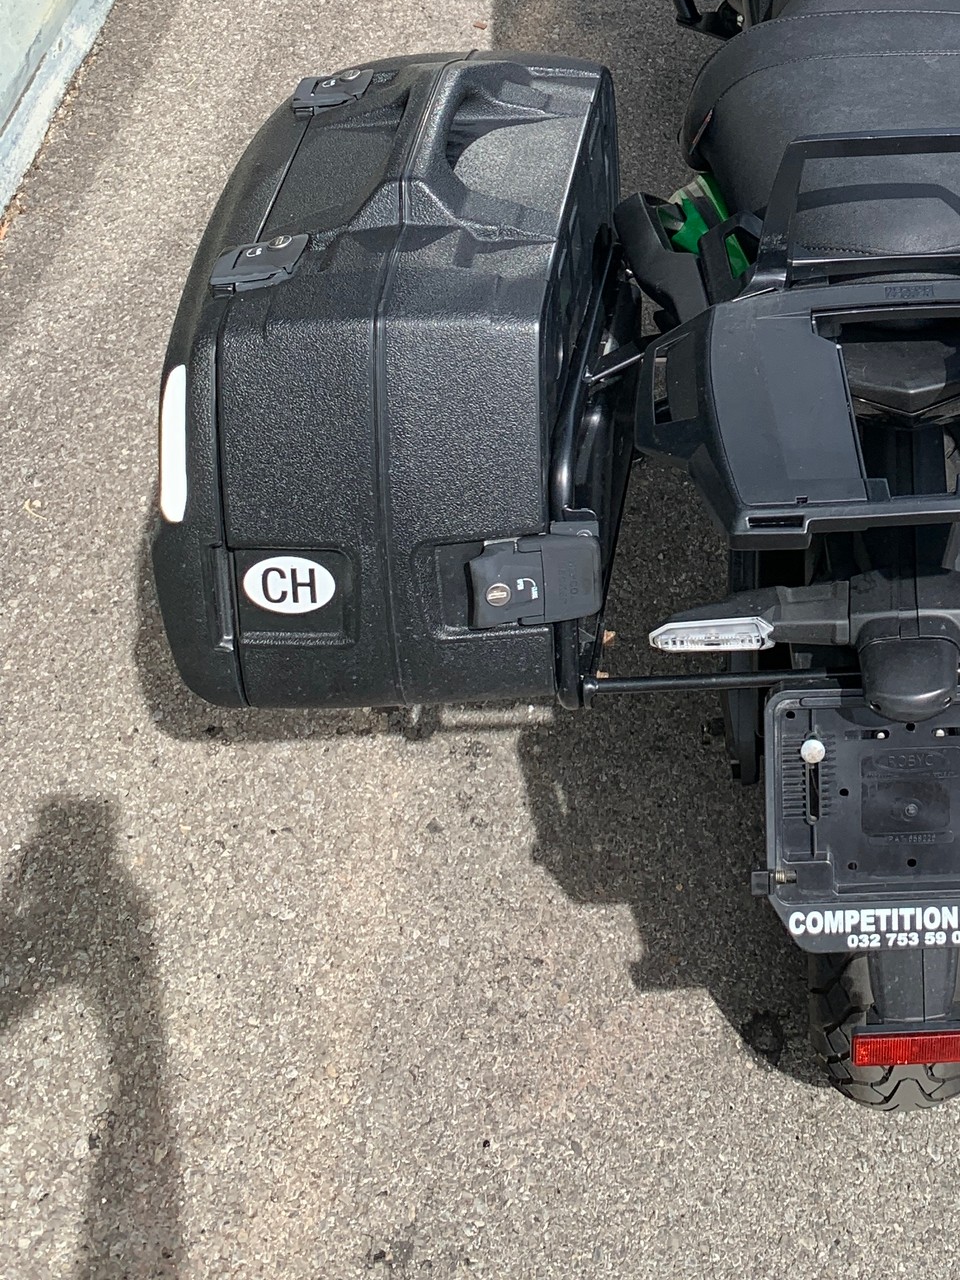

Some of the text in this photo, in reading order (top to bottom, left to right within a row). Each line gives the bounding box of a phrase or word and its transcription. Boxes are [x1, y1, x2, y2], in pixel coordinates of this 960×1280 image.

[261, 567, 317, 604] CH
[788, 906, 959, 935] COMPETITION
[847, 934, 881, 948] 032
[886, 932, 920, 946] 753
[924, 931, 947, 945] 59
